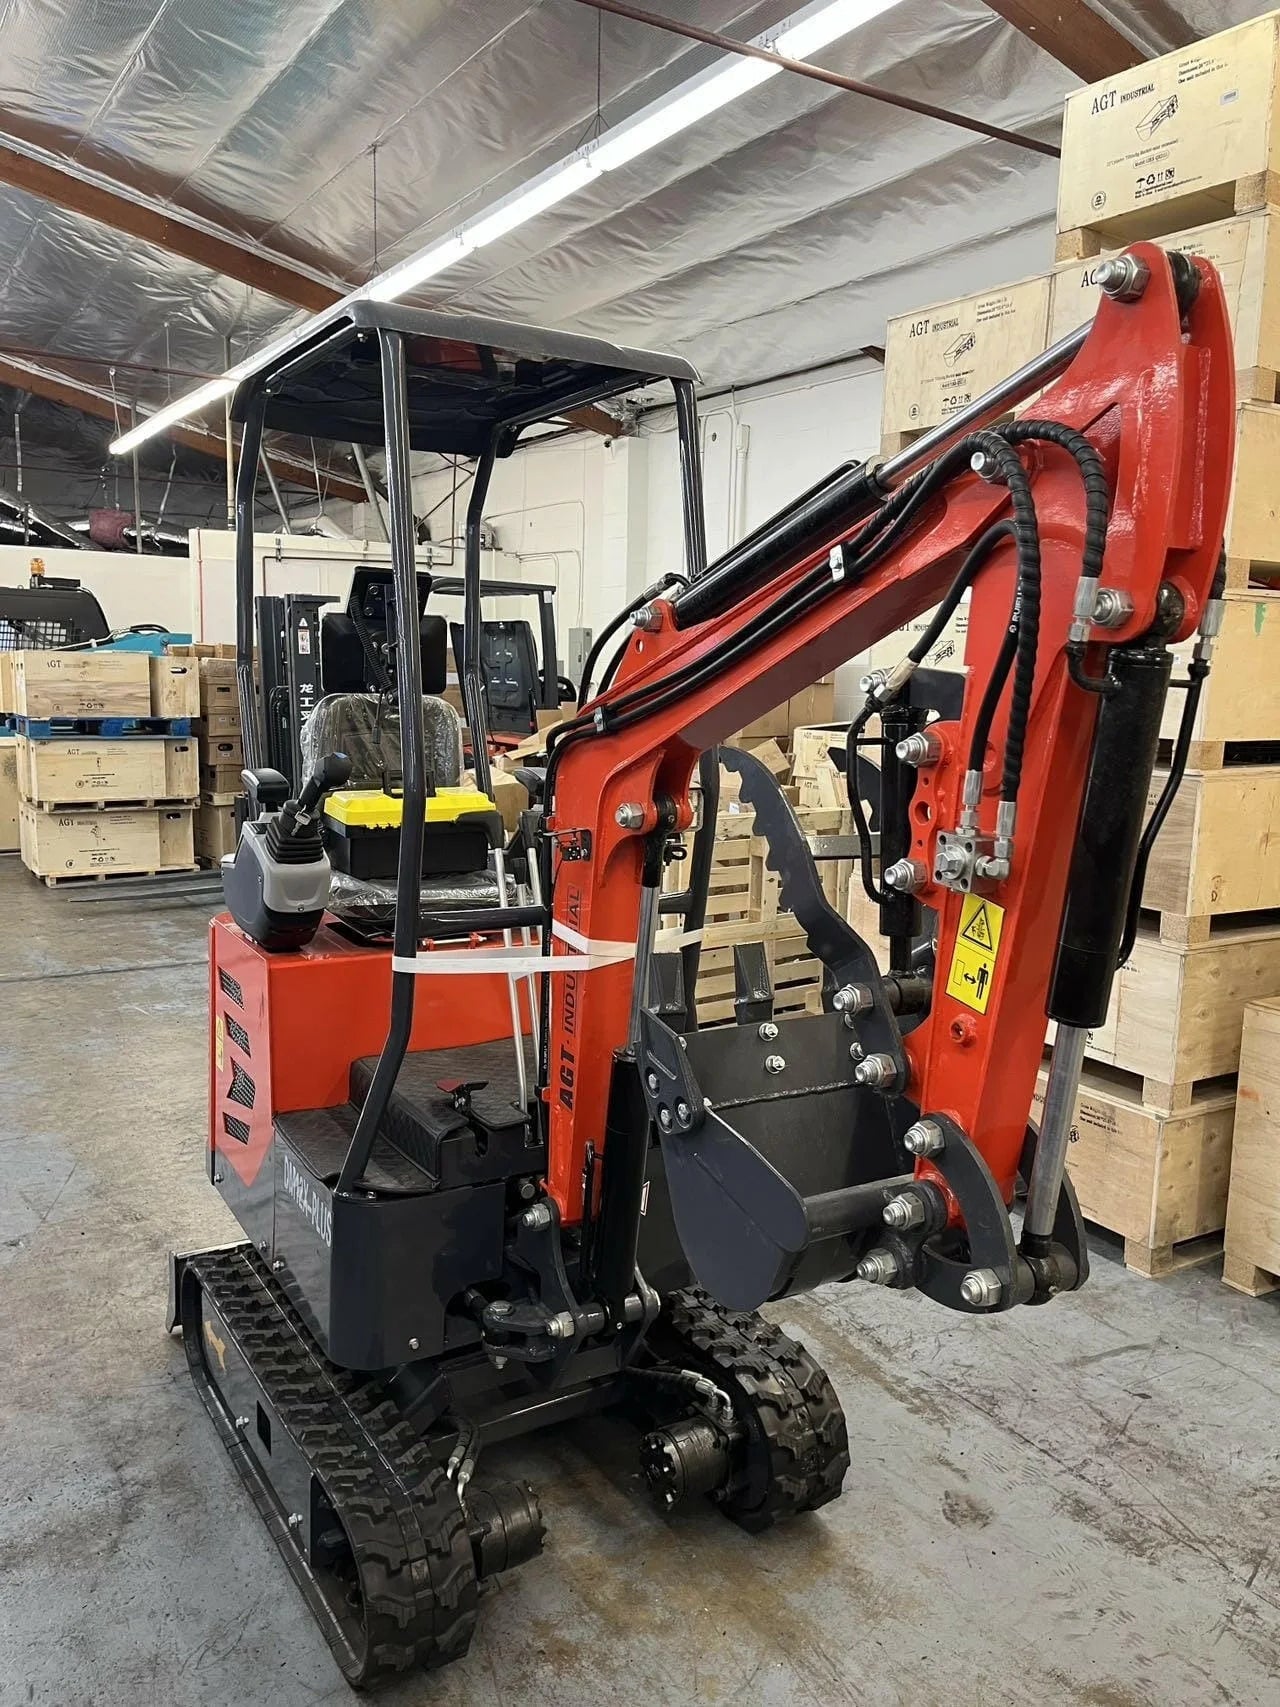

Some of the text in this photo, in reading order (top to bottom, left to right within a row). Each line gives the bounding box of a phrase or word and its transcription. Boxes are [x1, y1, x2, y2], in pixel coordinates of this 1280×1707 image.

[1092, 83, 1155, 115] AGT INDUSTRIAL
[909, 318, 959, 338] AGT INDUSTRIAL
[300, 683, 314, 730] 龙工叉
[67, 748, 80, 756] AGT
[560, 889, 580, 1112] AGT INDUTIAL
